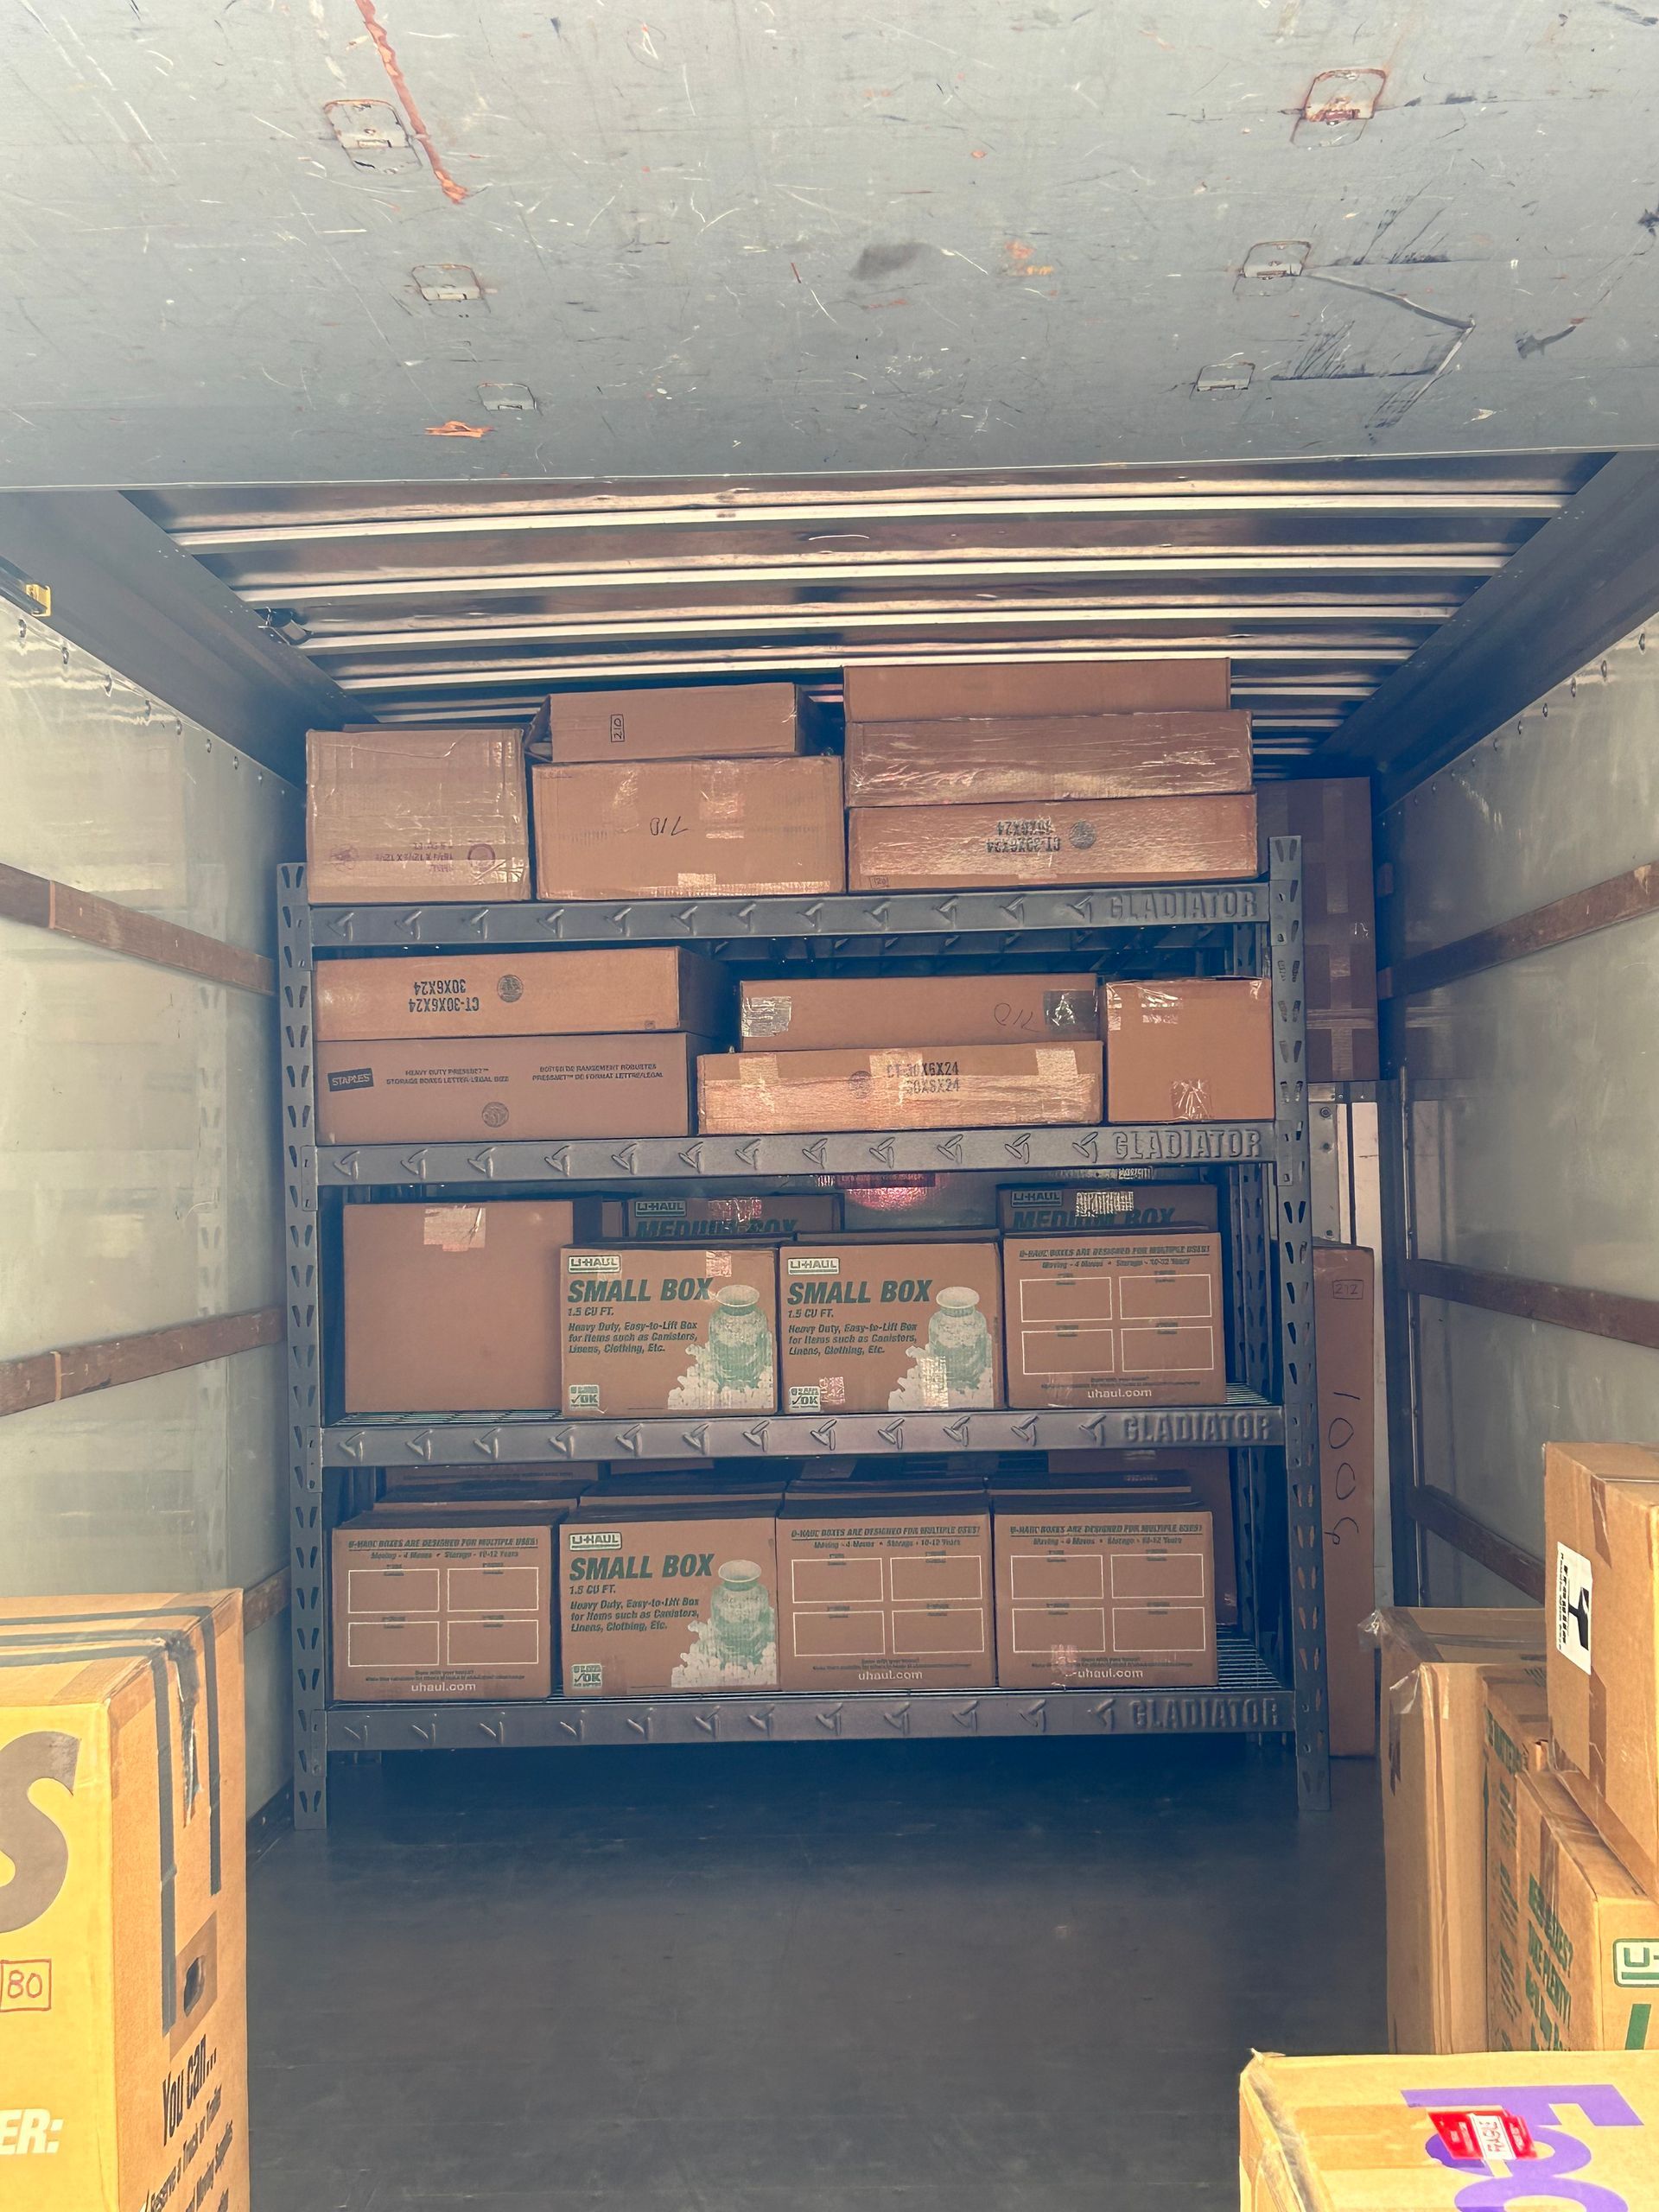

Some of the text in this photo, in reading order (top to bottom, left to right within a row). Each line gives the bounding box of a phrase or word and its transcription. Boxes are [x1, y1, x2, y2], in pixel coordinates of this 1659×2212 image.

[613, 718, 623, 740] 210
[1110, 890, 1258, 919] GLADIATOR
[413, 979, 467, 995] 30X6X24
[408, 996, 480, 1013] CT-30X6X24
[331, 1072, 371, 1086] STAPLES
[1112, 1128, 1262, 1160] GLADIATOR
[1013, 1192, 1060, 1201] U-HAUL
[637, 1202, 684, 1211] U-HAUL
[570, 1256, 618, 1267] U-HAUL
[790, 1260, 837, 1269] U-HAUL
[568, 1277, 715, 1303] SMALL BOX
[787, 1279, 933, 1306] SMALL BOX
[568, 1306, 614, 1317] 1.5 CU FT.
[788, 1308, 834, 1319] 1.5 CU FT.
[568, 1320, 697, 1333] Heavy Duty, Easy-to-Lift Box
[788, 1322, 918, 1336] Heavy Duty, Easy-to-Lift Box
[569, 1333, 582, 1343] for
[584, 1333, 611, 1343] Items
[613, 1332, 635, 1342] such
[651, 1332, 698, 1342] Canisters,
[788, 1334, 803, 1344] for
[804, 1334, 830, 1344] Items
[832, 1333, 855, 1344] such
[871, 1333, 917, 1343] Canisters,
[569, 1344, 601, 1354] Linens,
[604, 1344, 645, 1355] Clothing,
[789, 1344, 886, 1357] Linens, Clothing, Etc.
[1087, 1389, 1153, 1398] uhaul.com
[1123, 1413, 1270, 1443] GLADIATOR
[572, 1535, 619, 1545] U-HAUL
[569, 1554, 715, 1581] SMALL BOX
[569, 1584, 616, 1595] 1.5 CU FT.
[570, 1597, 700, 1611] Heavy Duty, Easy-to-Lift Box
[570, 1611, 583, 1621] for
[586, 1611, 612, 1621] Items
[615, 1610, 637, 1619] such
[653, 1609, 700, 1619] Canisters,
[571, 1620, 668, 1632] Linens, Clothing, Etc.
[858, 1670, 923, 1681] uhaul.com
[1077, 1669, 1143, 1678] uhaul.com
[411, 1681, 476, 1692] uhaul.com
[1129, 1698, 1279, 1728] GLADIATOR
[162, 2033, 217, 2147] You can...
